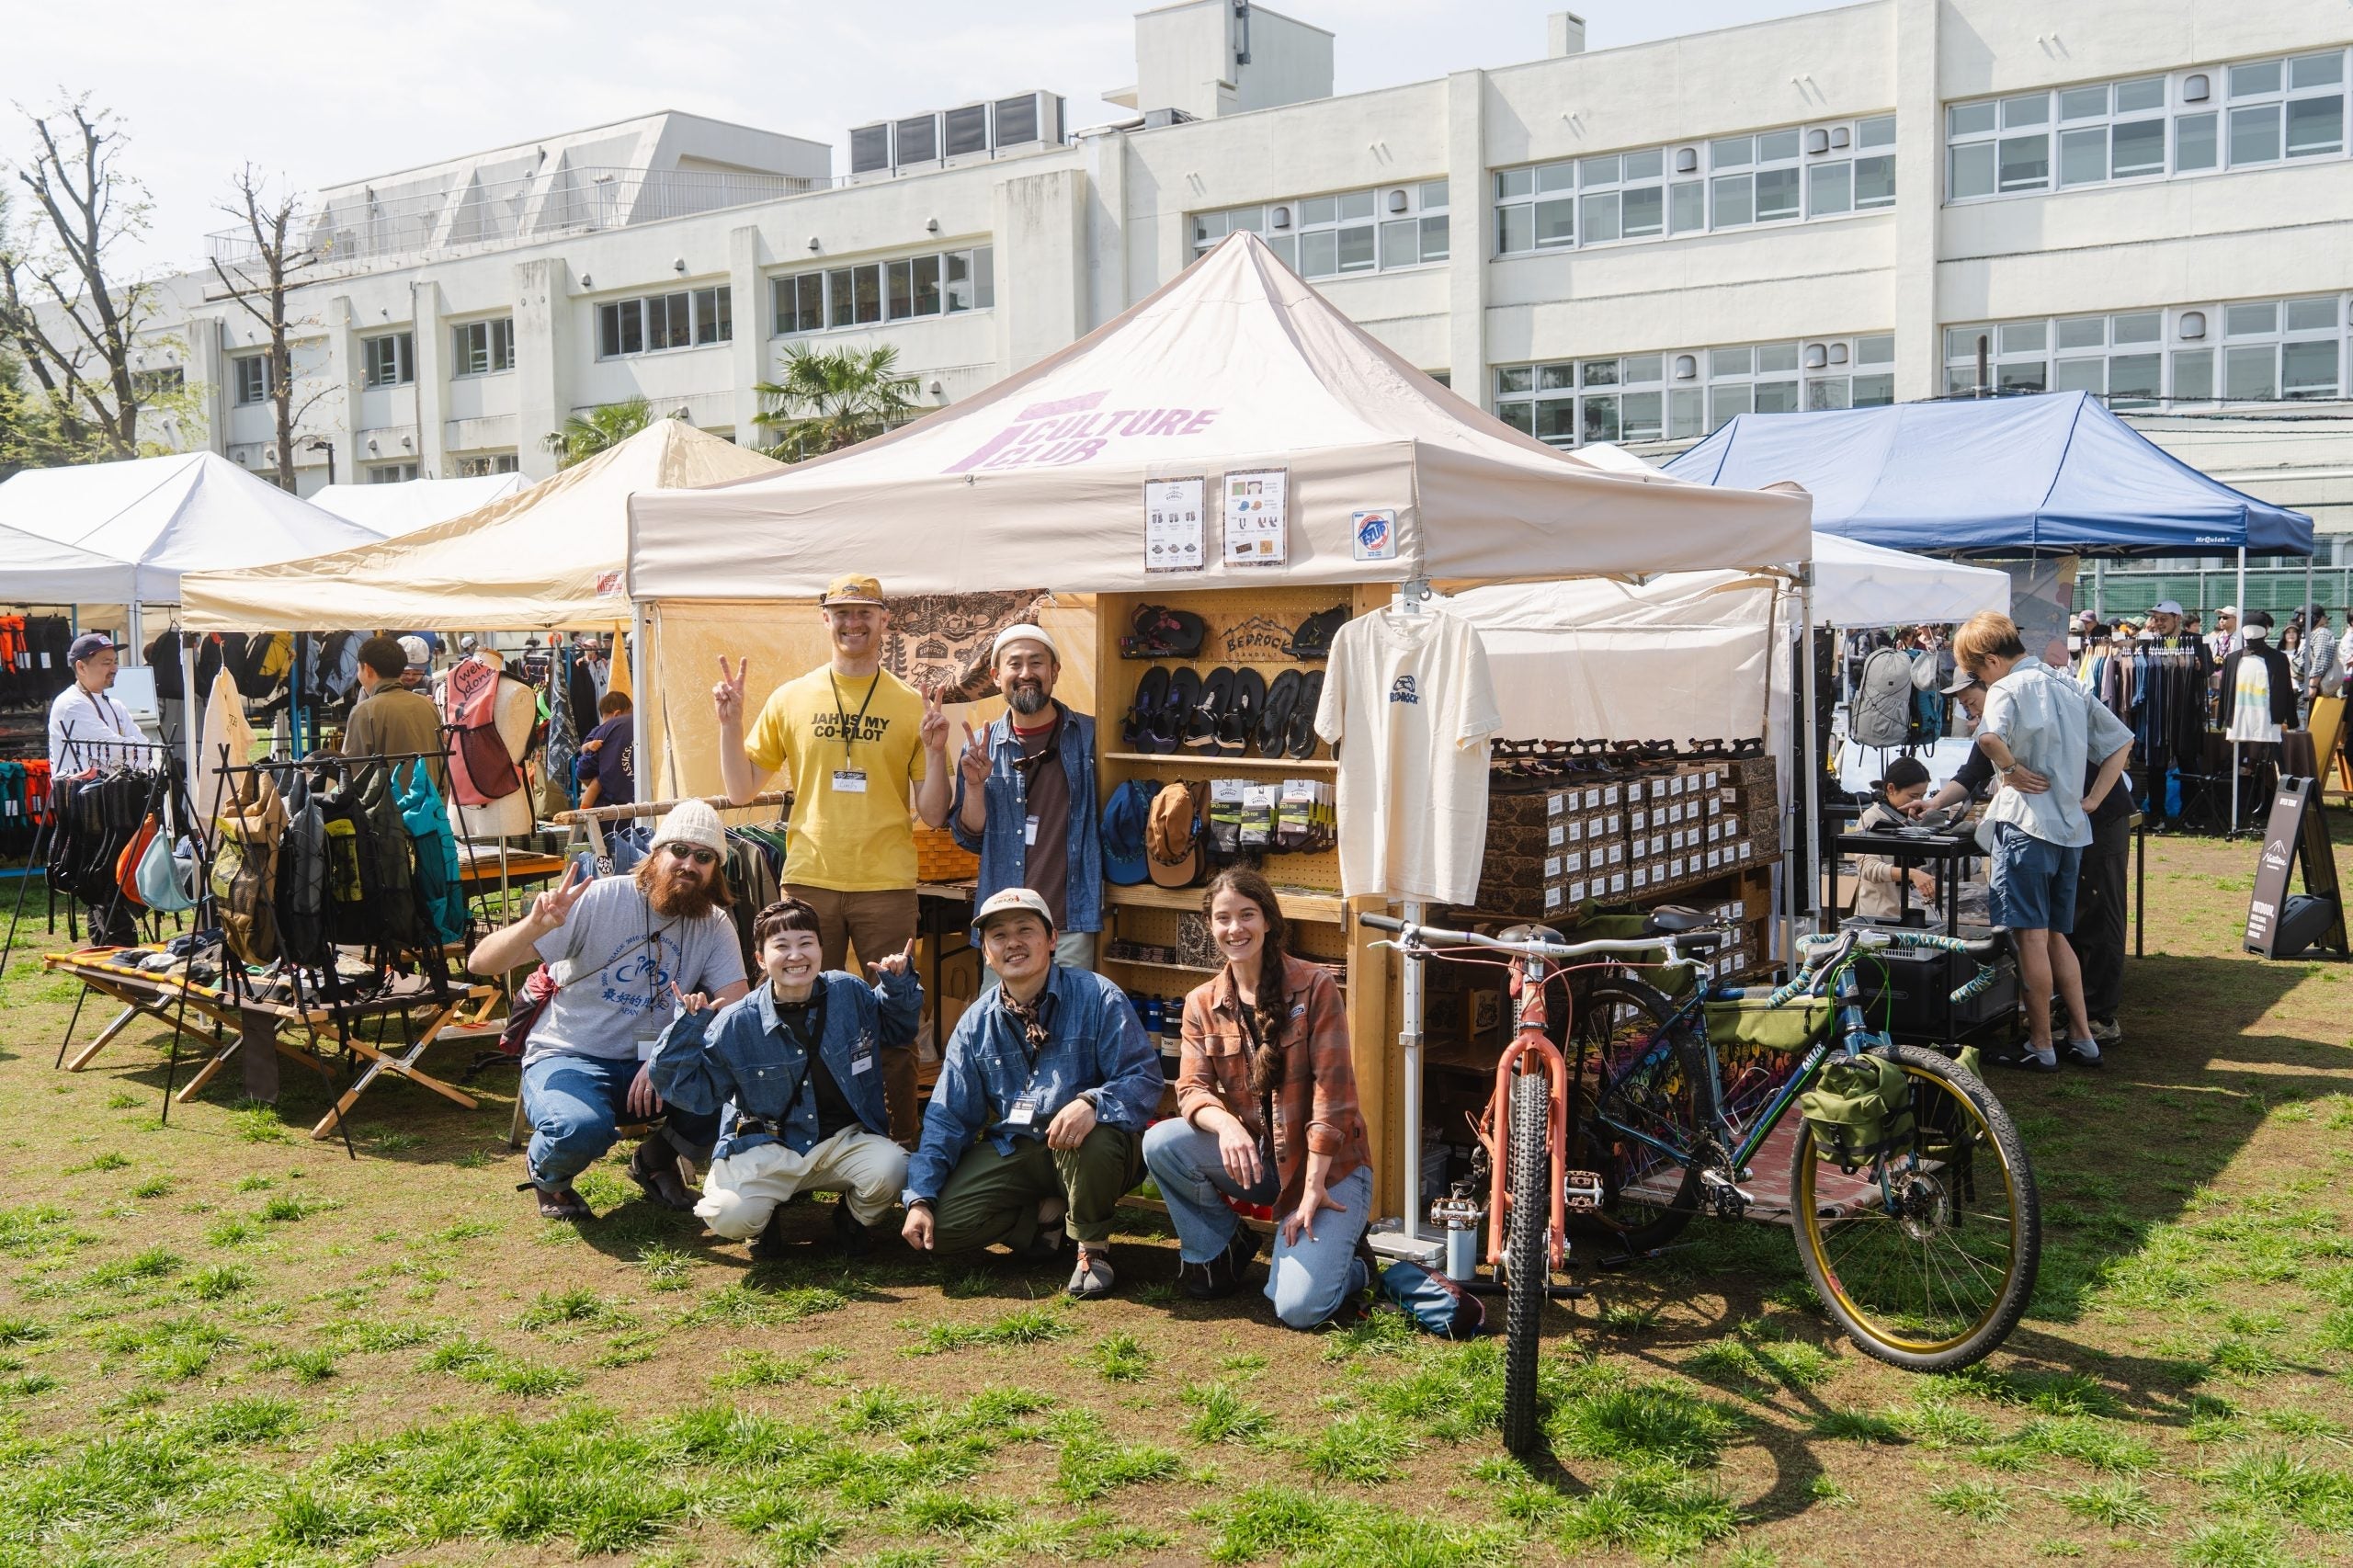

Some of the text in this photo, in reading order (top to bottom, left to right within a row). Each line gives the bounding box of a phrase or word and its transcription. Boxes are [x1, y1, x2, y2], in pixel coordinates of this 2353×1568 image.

[1017, 408, 1222, 445] CULTURE
[983, 438, 1108, 467] CLUB
[1226, 632, 1290, 653] BEDROCK
[1390, 691, 1418, 705] BEDROCK
[812, 712, 890, 730] JAH IS MY
[814, 725, 883, 741] CO-PILOT
[621, 745, 634, 782] ASSICS.
